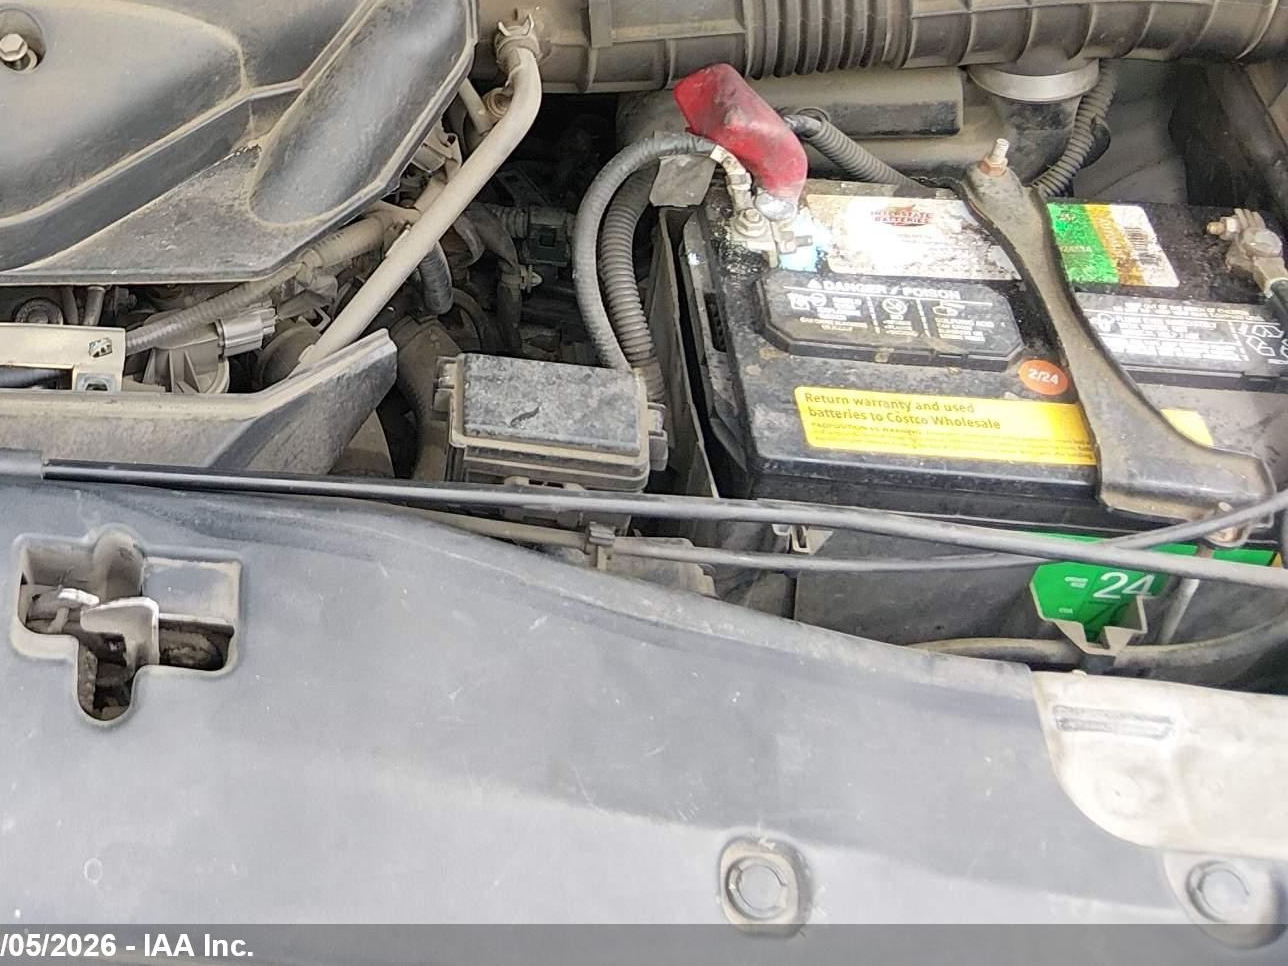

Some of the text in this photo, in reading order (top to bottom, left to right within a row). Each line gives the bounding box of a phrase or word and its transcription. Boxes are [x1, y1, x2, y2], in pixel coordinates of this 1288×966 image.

[823, 280, 887, 295] DANGER
[902, 287, 961, 300] POISON
[1027, 368, 1059, 385] 2/24
[804, 392, 975, 414] Return warranty and used
[808, 406, 1001, 429] batteries to Costco Wholesale
[1093, 571, 1158, 599] 24
